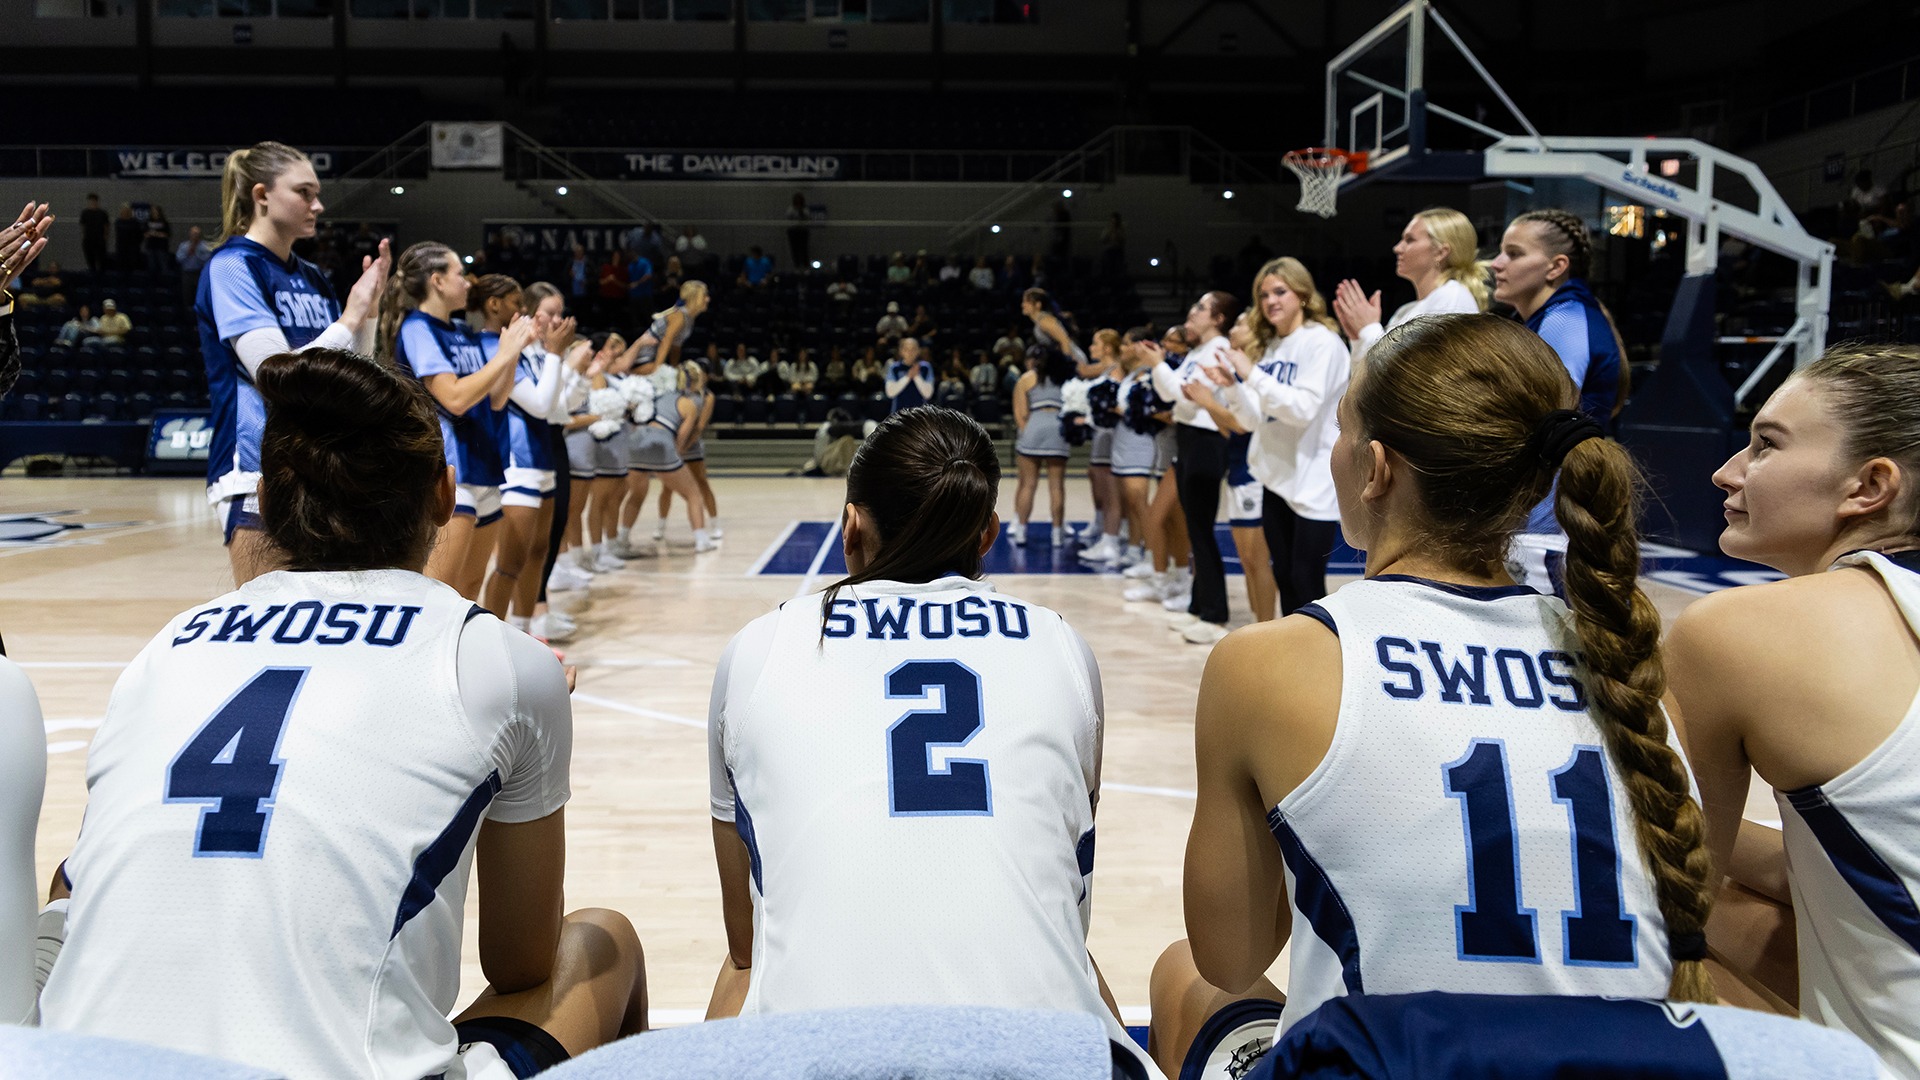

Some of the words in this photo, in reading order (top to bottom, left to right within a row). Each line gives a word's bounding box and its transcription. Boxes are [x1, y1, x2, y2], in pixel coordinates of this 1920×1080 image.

[118, 152, 228, 171] WELCO
[624, 154, 674, 173] THE
[682, 154, 840, 175] DAWGPOUND
[172, 600, 424, 648] SWOSU
[822, 595, 1031, 641] SWOSU
[1374, 635, 1594, 713] SWOS
[162, 665, 312, 859] 4
[884, 658, 994, 818] 2
[1441, 737, 1639, 969] 11
